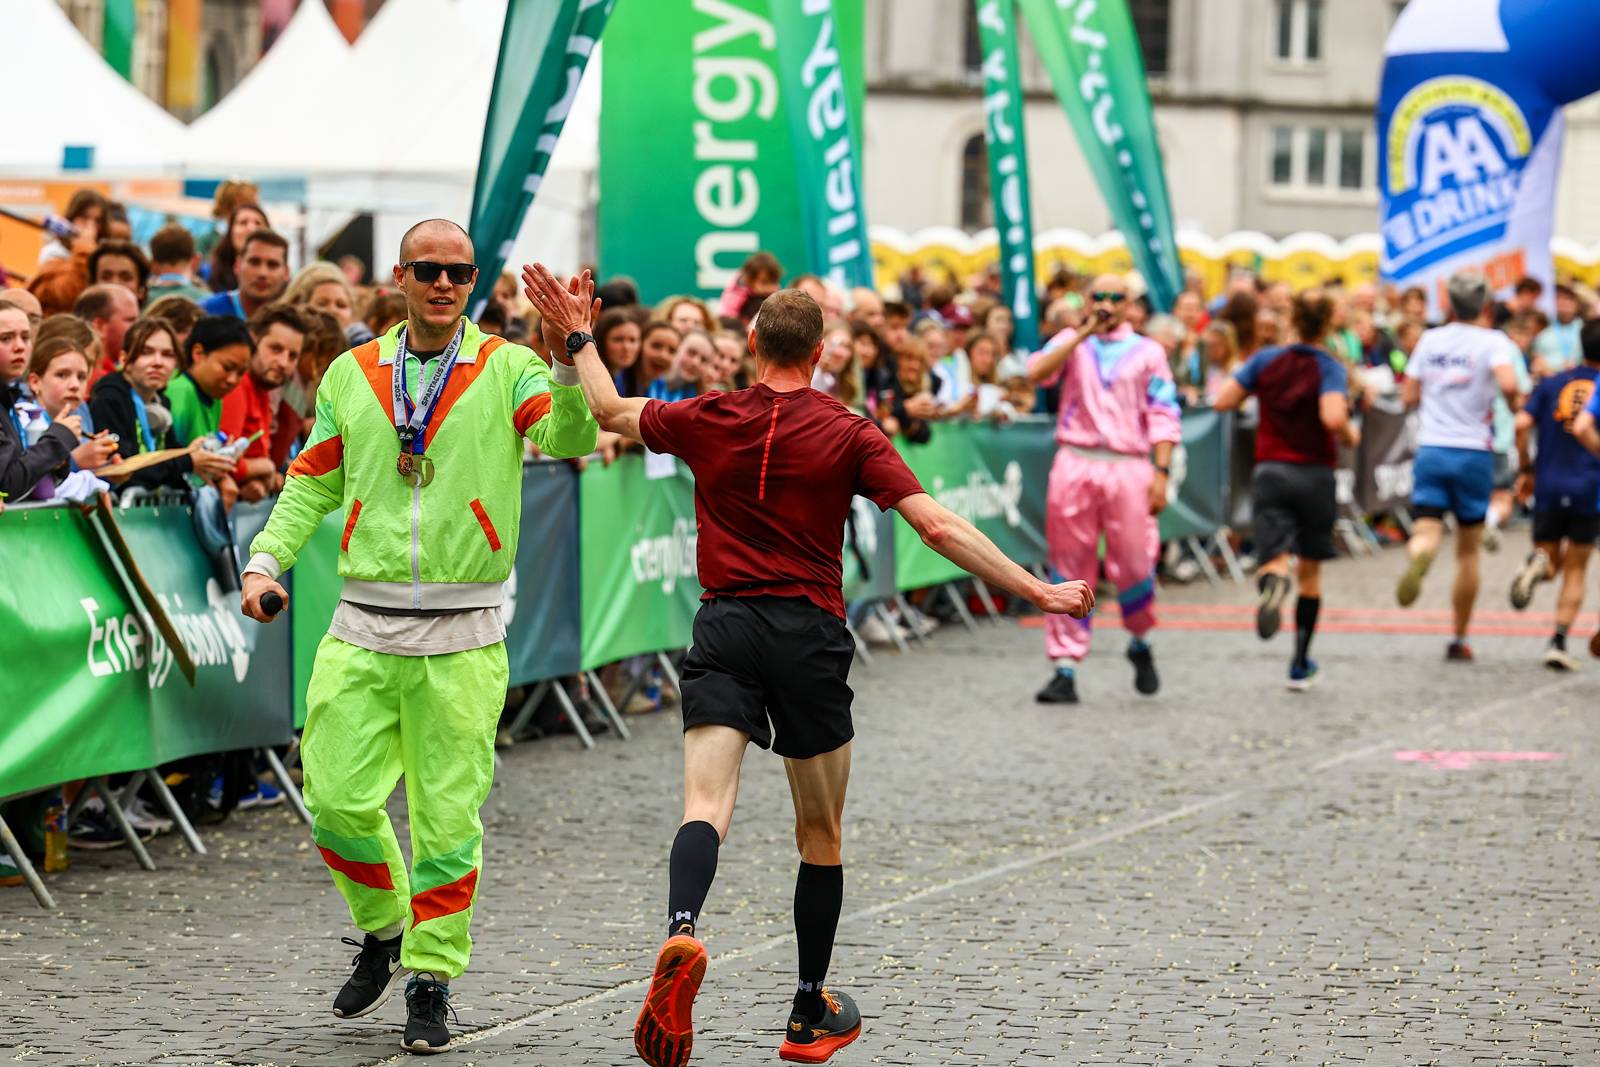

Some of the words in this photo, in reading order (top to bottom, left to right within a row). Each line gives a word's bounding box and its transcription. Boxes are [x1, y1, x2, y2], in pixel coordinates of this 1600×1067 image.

[693, 0, 777, 289] nergy
[1421, 115, 1507, 196] AA
[422, 367, 444, 407] SPARTACUS
[441, 344, 457, 368] FAMILY
